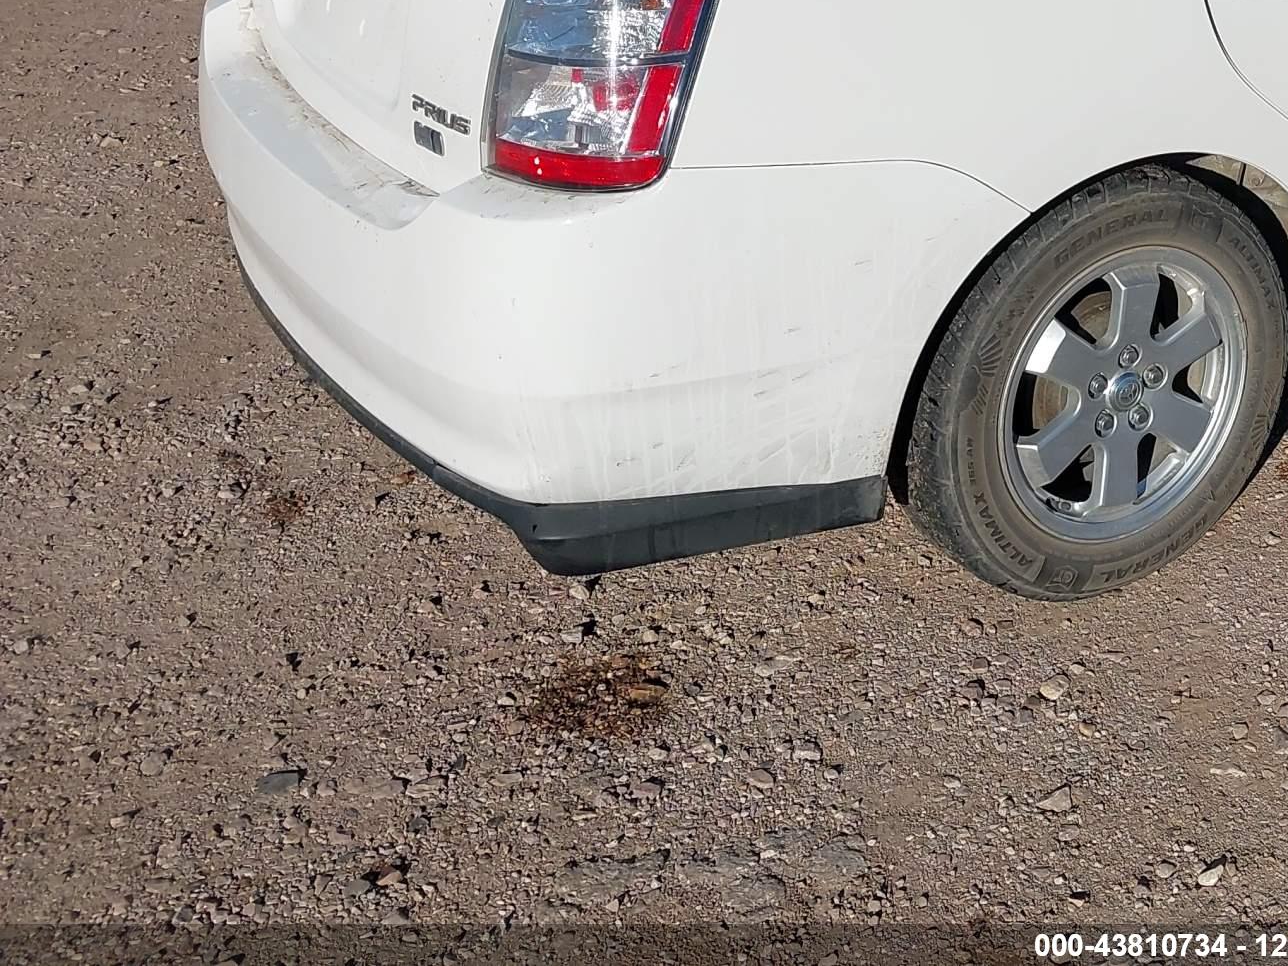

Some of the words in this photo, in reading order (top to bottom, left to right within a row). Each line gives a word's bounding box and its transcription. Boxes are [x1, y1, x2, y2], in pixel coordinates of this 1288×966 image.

[411, 93, 472, 136] PRIUS
[1053, 208, 1170, 268] GENERAL
[1228, 236, 1279, 310] ALTIMAX
[973, 491, 1034, 567] ALTIMAX
[1100, 512, 1210, 584] GENERAL
